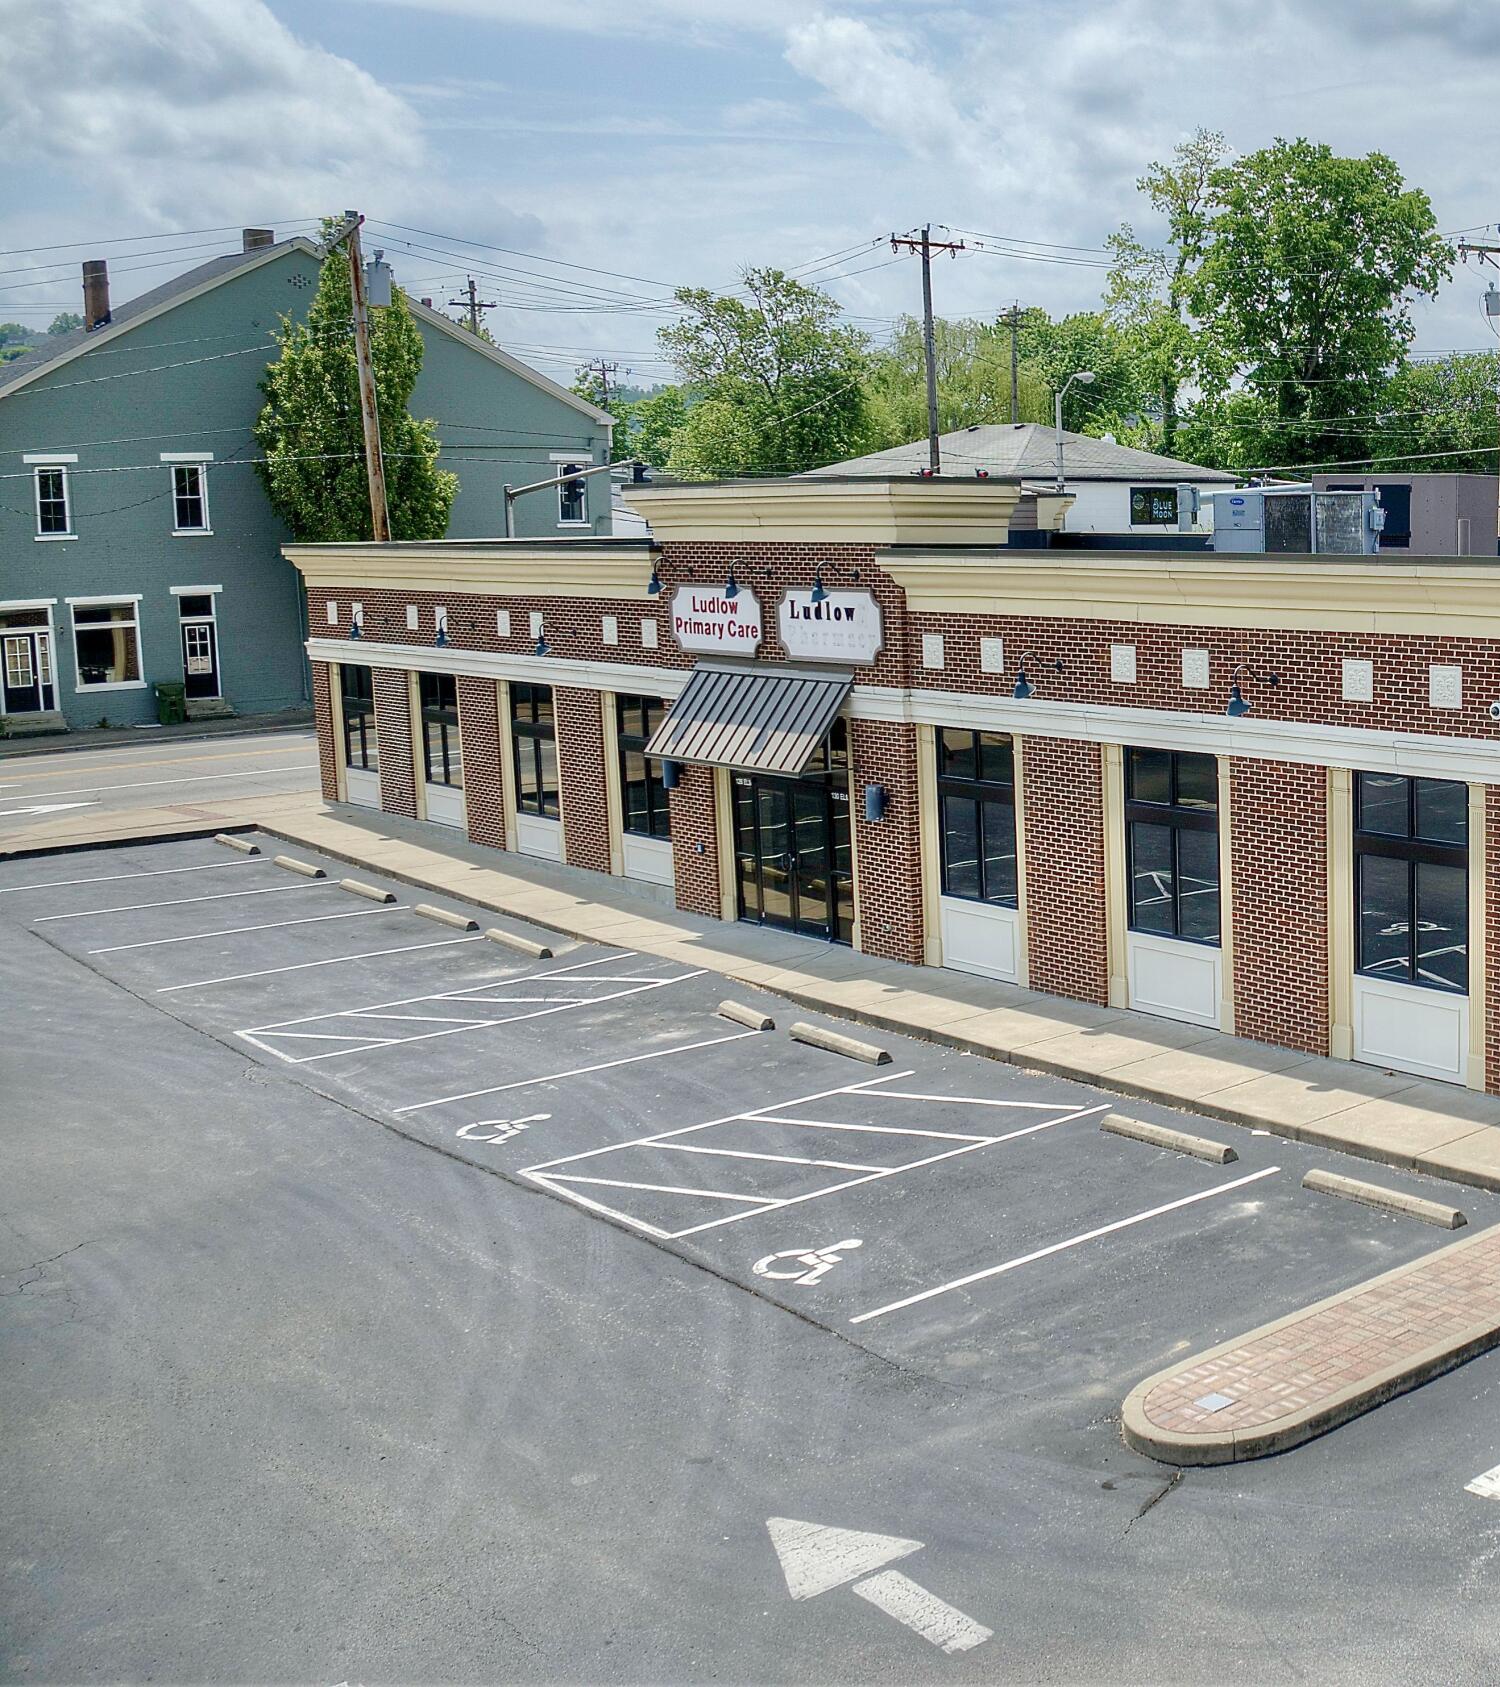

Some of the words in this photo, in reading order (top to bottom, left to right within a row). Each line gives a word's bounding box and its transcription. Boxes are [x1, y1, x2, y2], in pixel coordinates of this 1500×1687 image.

[1152, 498, 1172, 510] BLUE
[1152, 510, 1173, 519] MOON
[692, 595, 738, 614] Ludlow
[789, 600, 855, 621] Ludlow
[675, 616, 724, 640] Primary
[727, 619, 759, 639] Care
